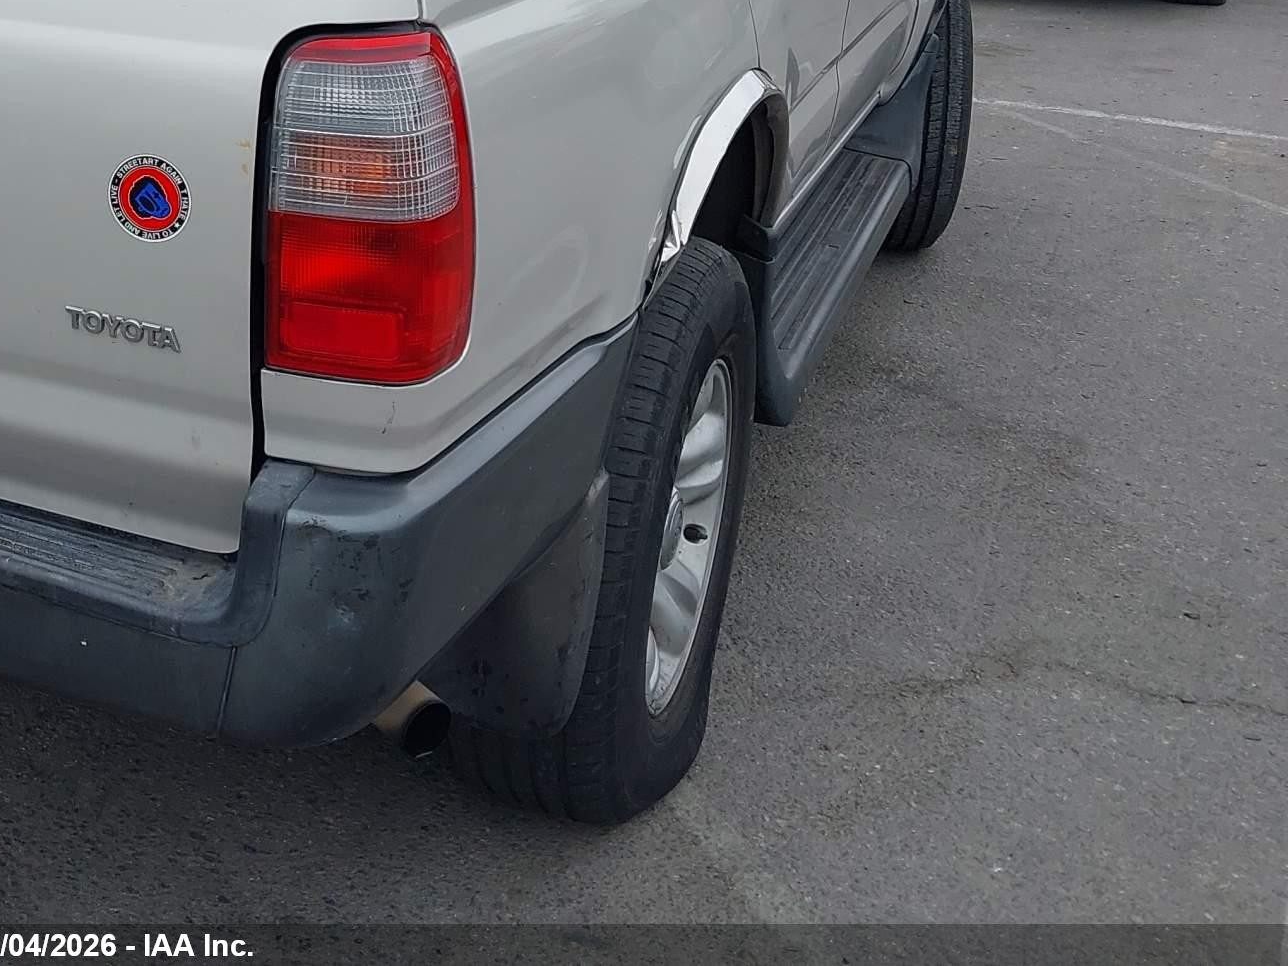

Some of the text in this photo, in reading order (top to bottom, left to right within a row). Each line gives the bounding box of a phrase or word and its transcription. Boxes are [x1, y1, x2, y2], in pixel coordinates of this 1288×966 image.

[116, 157, 159, 179] STREETART
[124, 221, 142, 236] AND
[141, 231, 161, 240] LIVE
[162, 228, 174, 238] TO
[65, 305, 181, 354] TOYOTA
